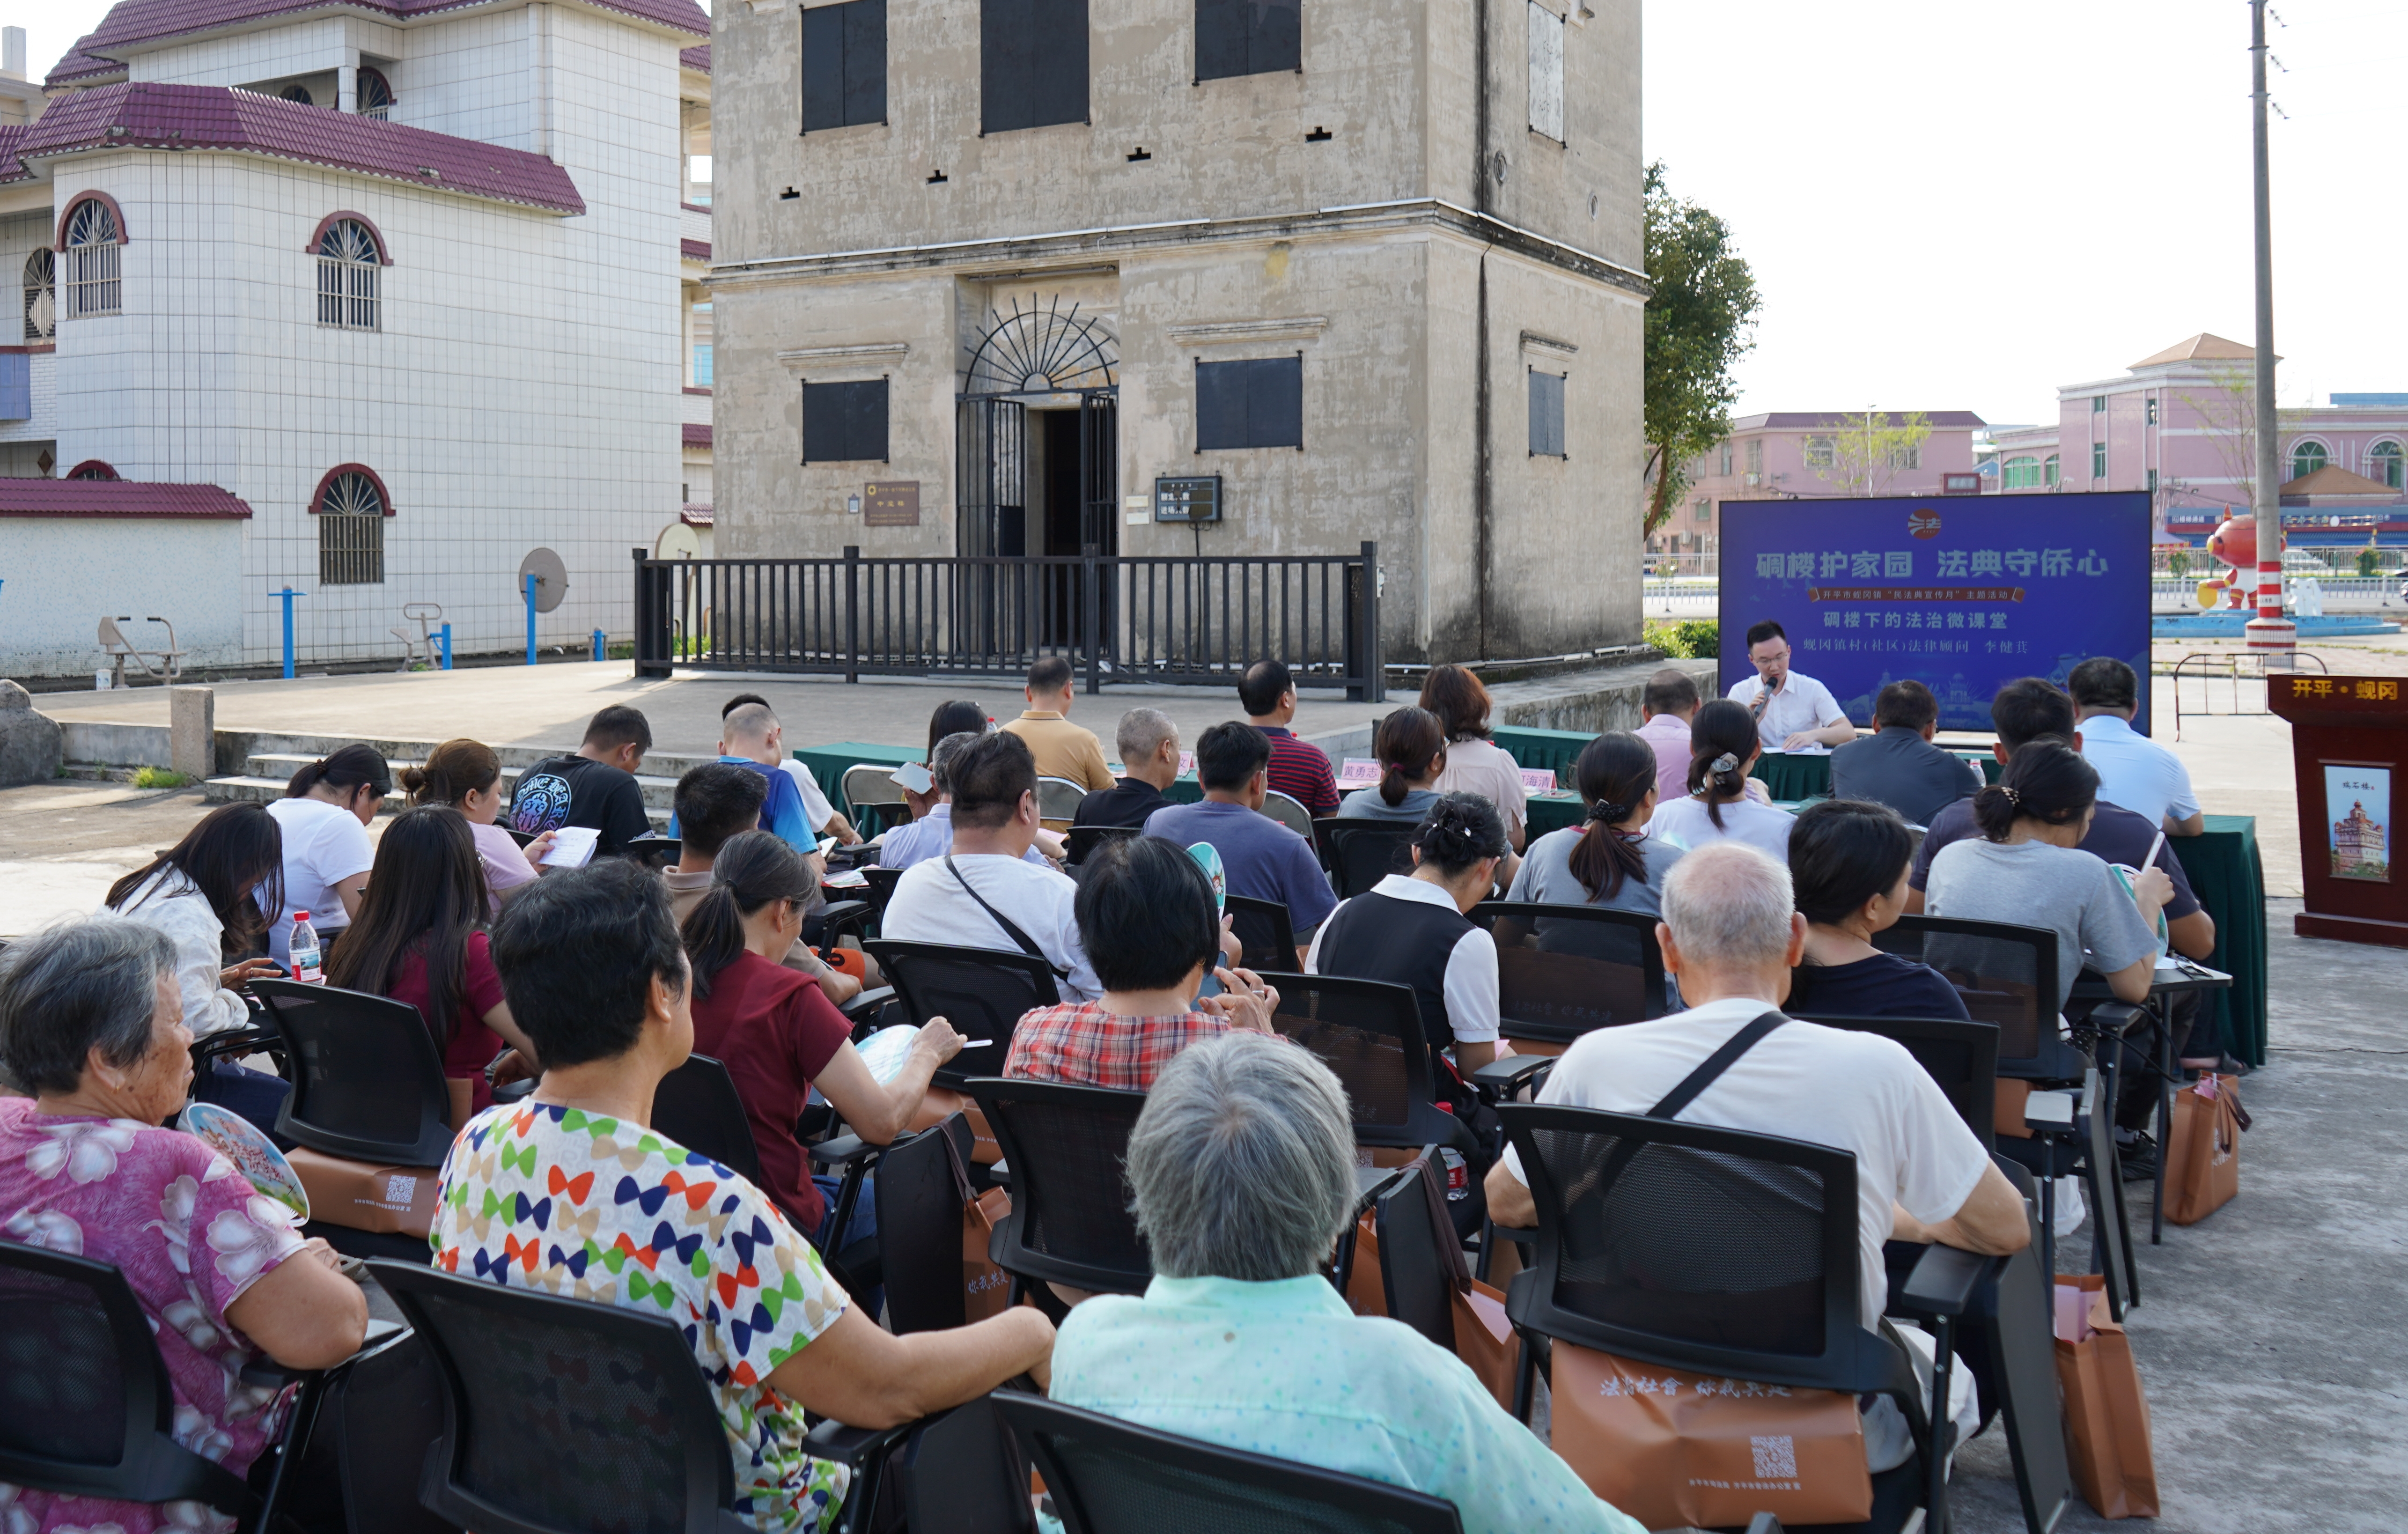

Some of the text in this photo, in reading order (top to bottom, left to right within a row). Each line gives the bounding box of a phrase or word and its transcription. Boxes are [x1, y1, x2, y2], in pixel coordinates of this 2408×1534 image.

[1756, 548, 2109, 579] 碉楼护家园 法典守侨心
[1823, 611, 2008, 630] 碉楼下的法治微课堂
[1343, 766, 1378, 778] 黄勇志
